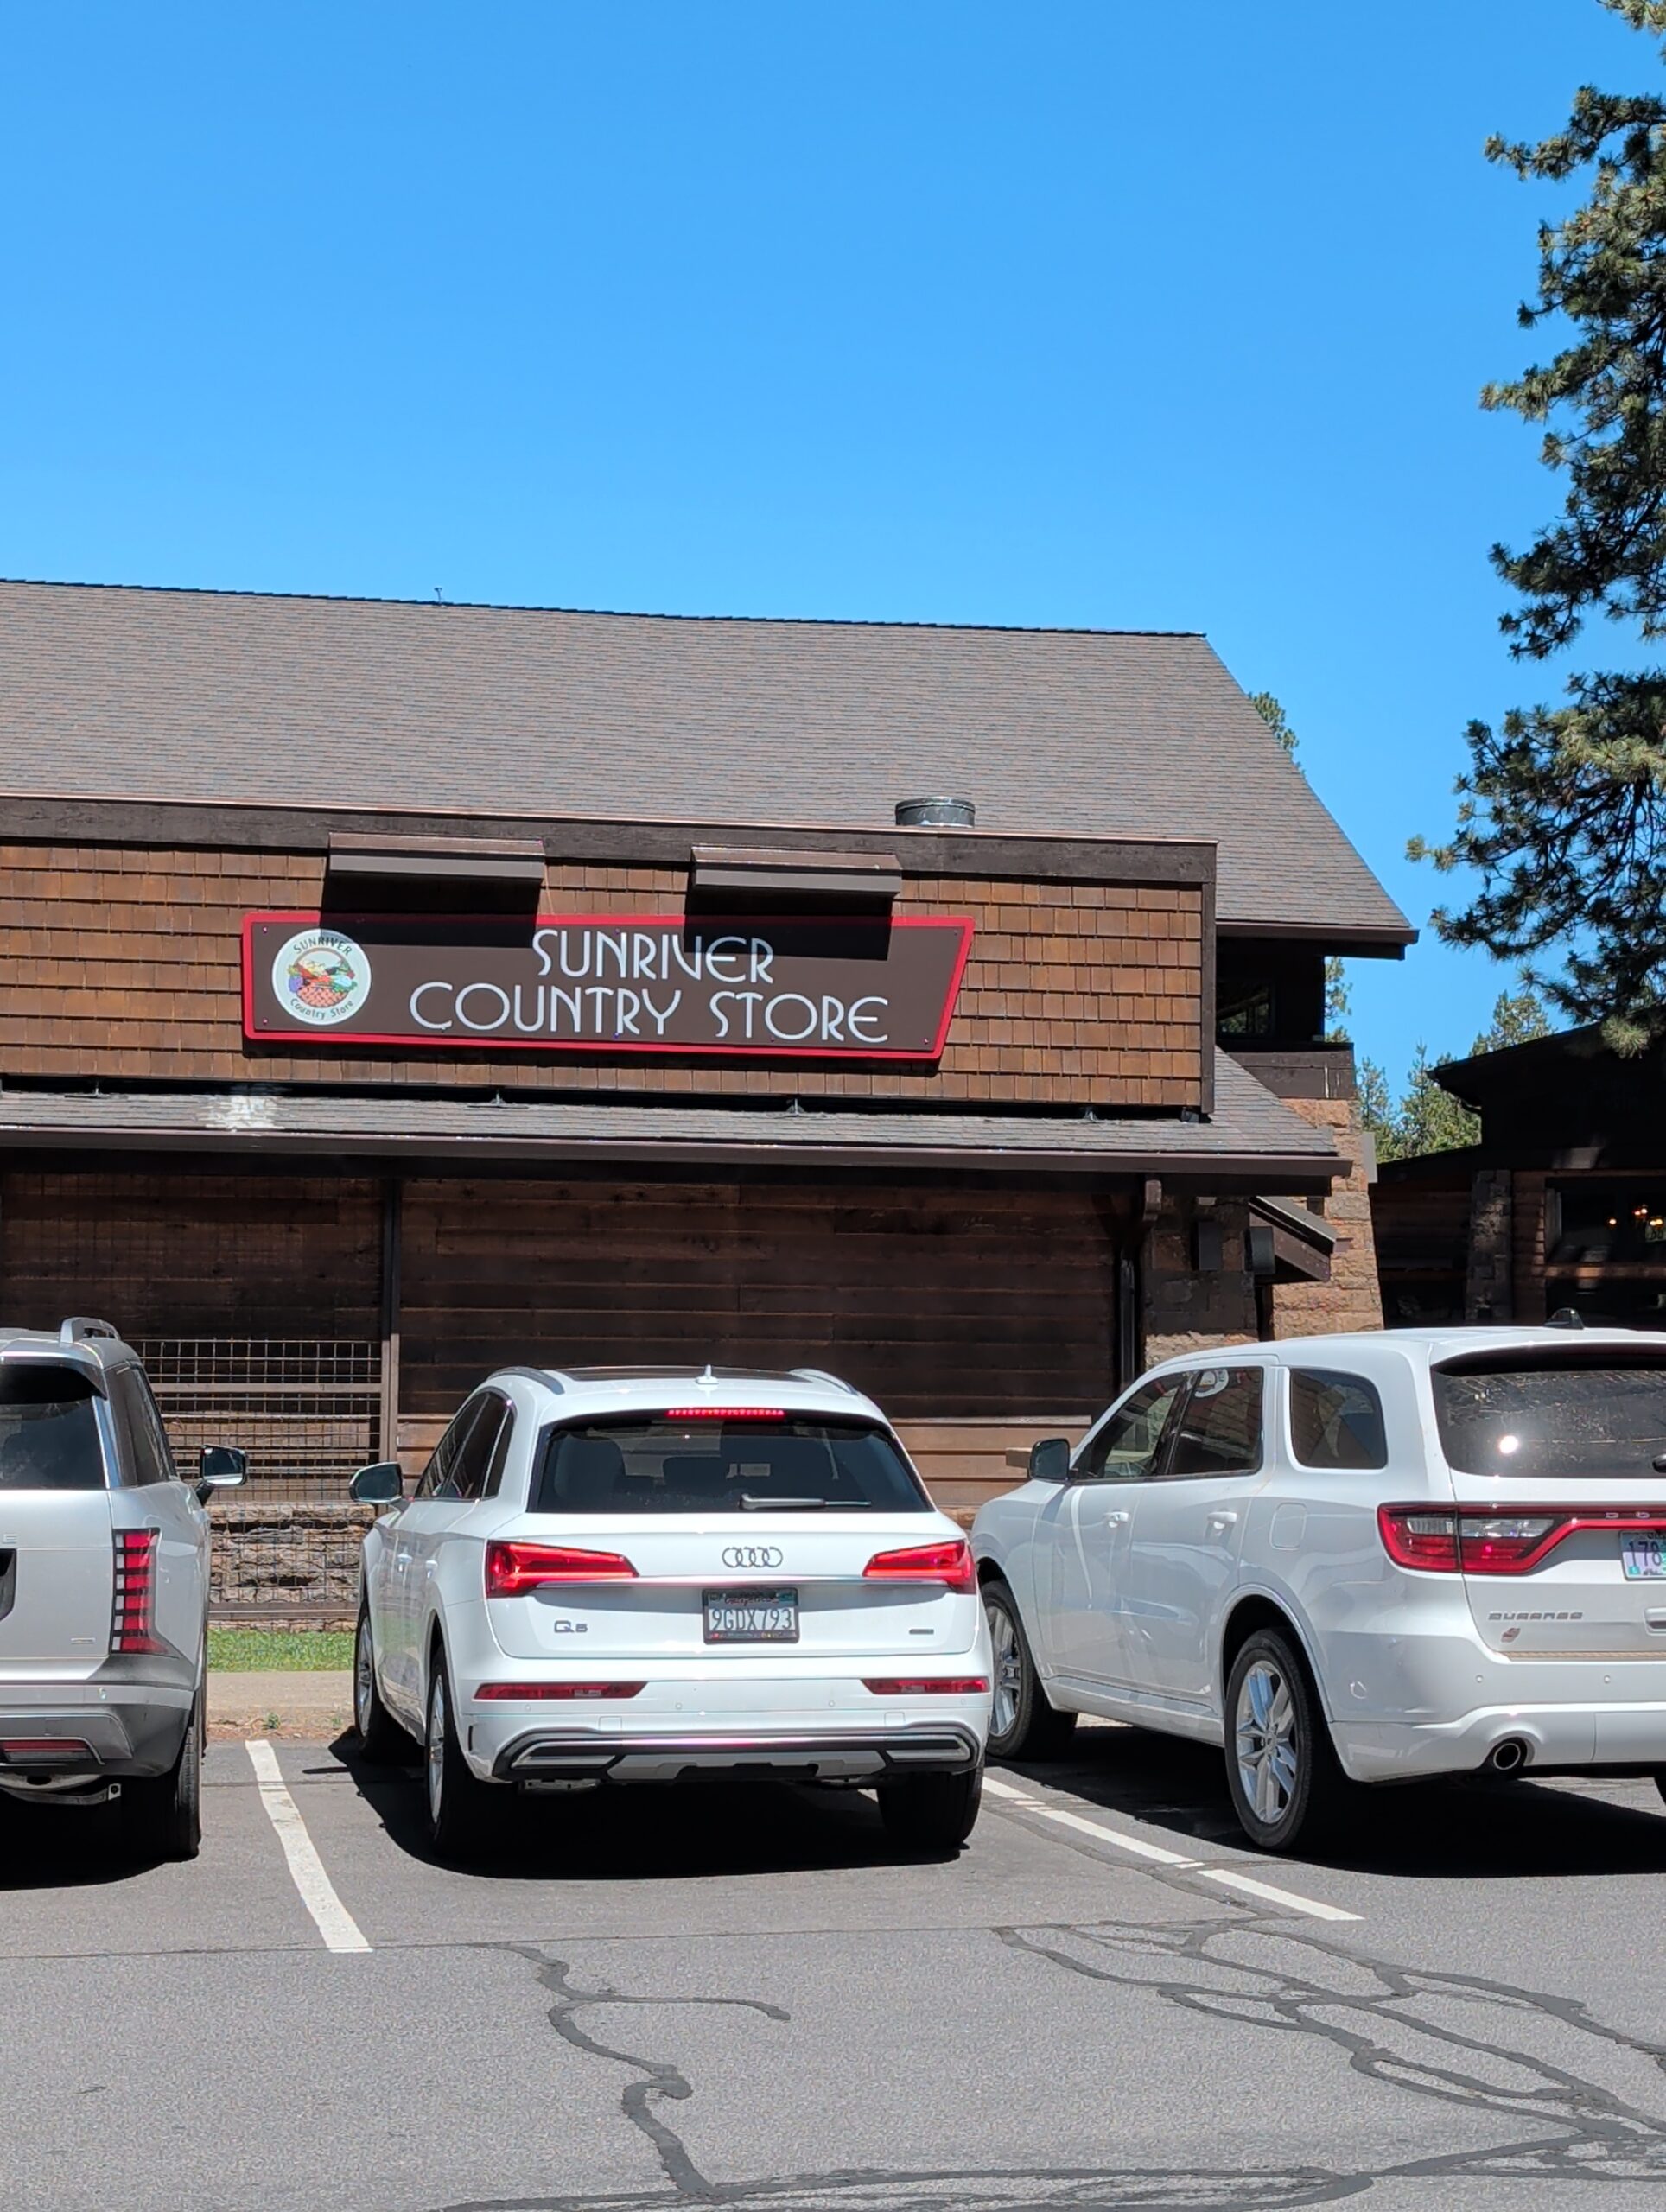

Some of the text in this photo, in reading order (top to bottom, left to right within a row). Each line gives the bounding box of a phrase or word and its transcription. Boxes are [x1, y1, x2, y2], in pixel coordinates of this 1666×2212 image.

[294, 936, 353, 956] SUNRIVER
[532, 929, 773, 983] SUNRIVER
[290, 998, 354, 1020] Country Store
[410, 982, 888, 1043] COUNTRY STORE
[554, 1620, 588, 1633] Q5
[712, 1607, 792, 1631] 9GDX793
